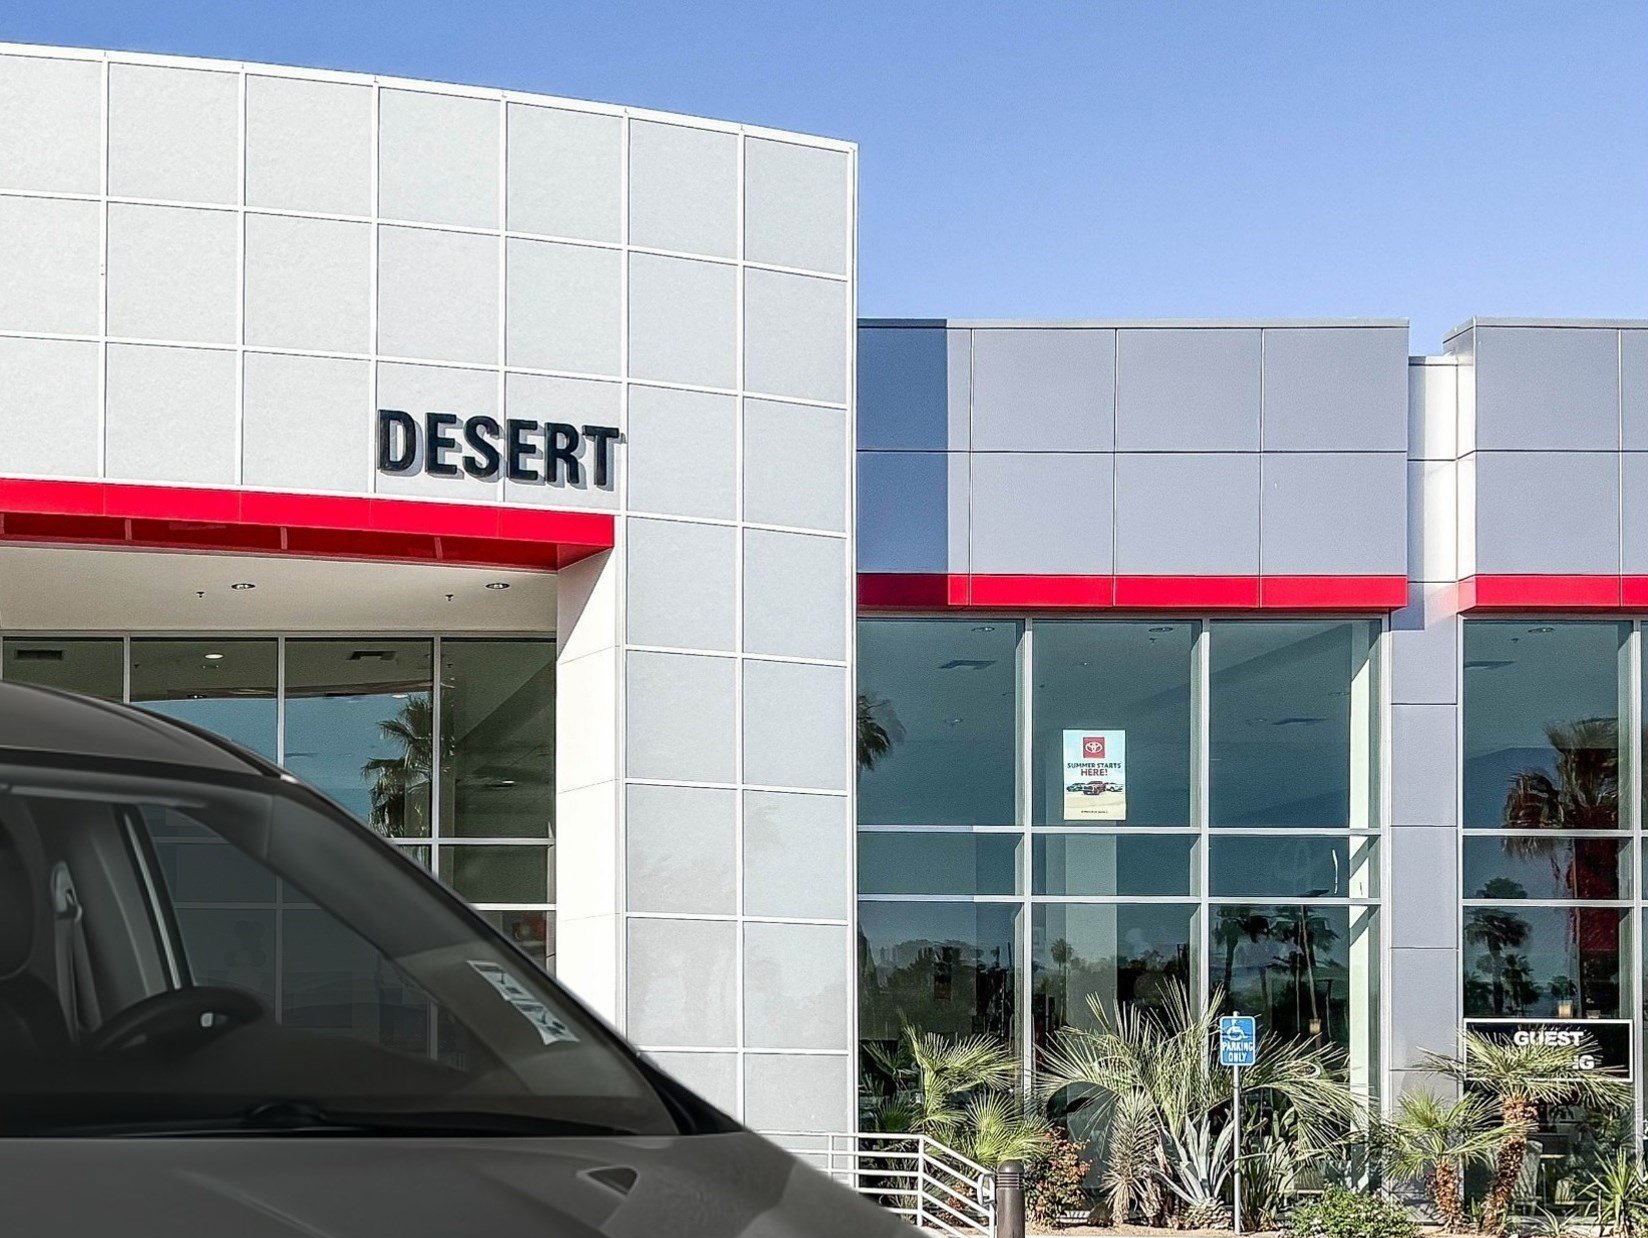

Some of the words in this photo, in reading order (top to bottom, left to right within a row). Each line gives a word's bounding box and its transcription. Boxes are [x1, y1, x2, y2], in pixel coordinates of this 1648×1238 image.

[377, 409, 620, 487] DESERT
[1080, 768, 1108, 777] HERE!
[1513, 1031, 1584, 1047] GUEST
[1222, 1041, 1254, 1052] PARKING
[1228, 1052, 1247, 1062] ONLY
